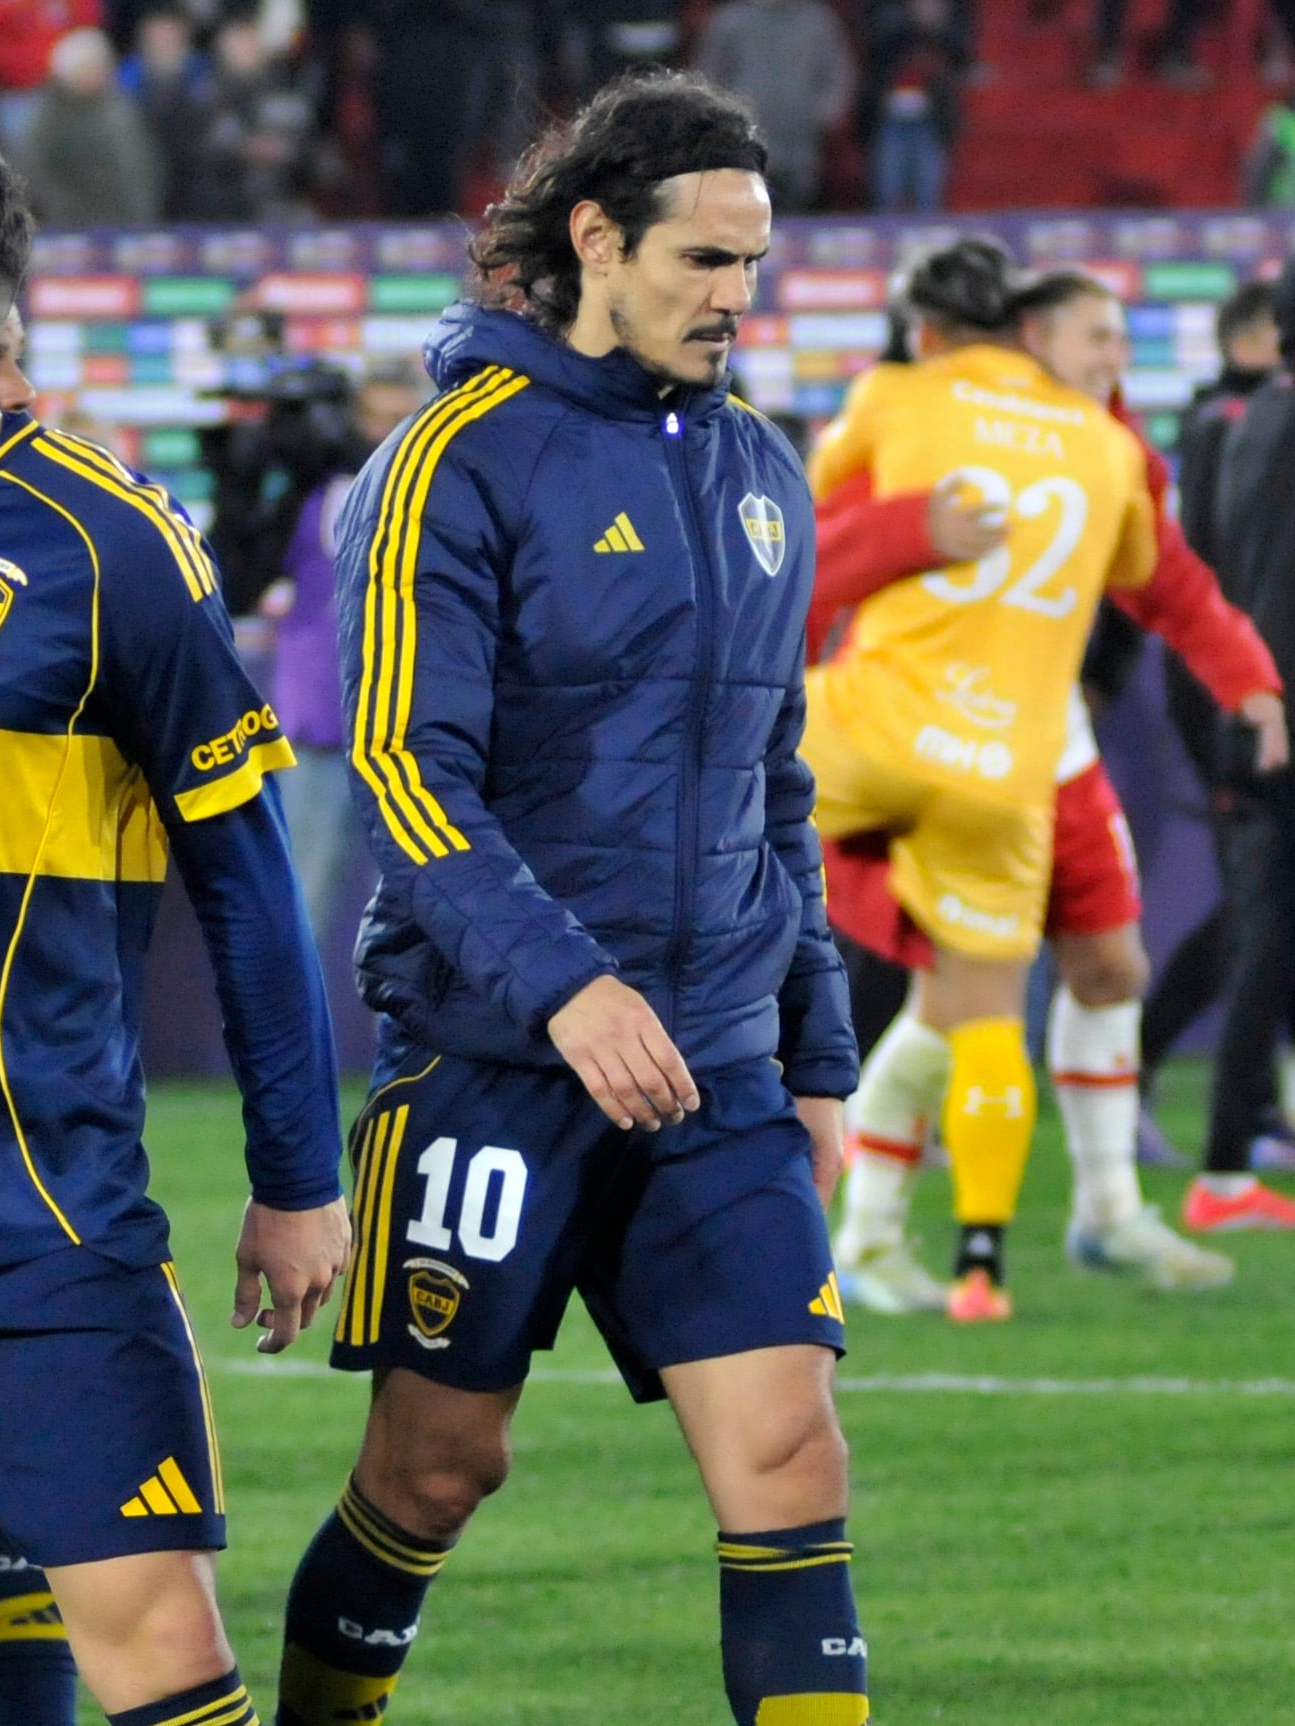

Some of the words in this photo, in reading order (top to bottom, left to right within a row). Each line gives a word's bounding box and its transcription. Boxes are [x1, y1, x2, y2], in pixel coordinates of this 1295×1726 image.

[973, 416, 1065, 460] MEZA
[921, 467, 1088, 618] 32
[406, 1136, 528, 1262] 10
